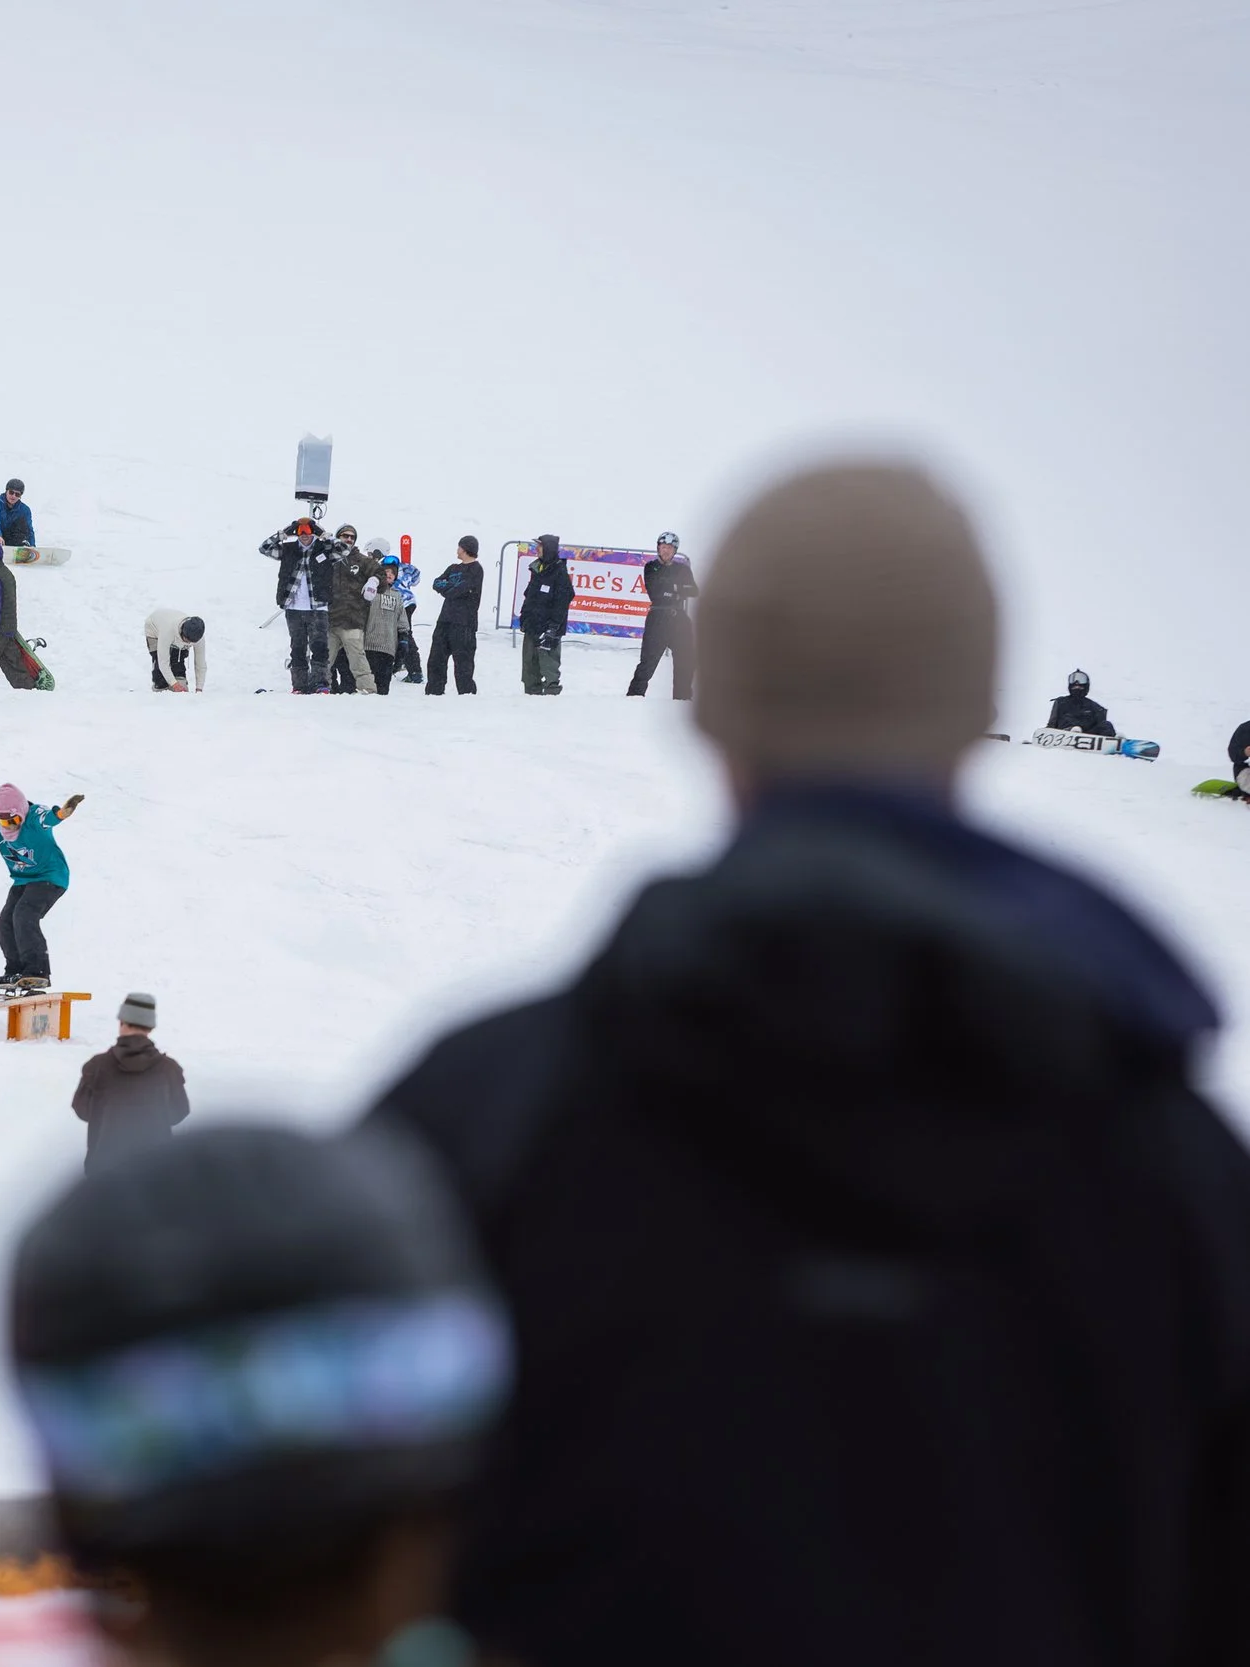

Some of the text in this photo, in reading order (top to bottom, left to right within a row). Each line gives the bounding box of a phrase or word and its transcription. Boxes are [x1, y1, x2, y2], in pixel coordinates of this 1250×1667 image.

[568, 566, 623, 592] ine's
[592, 601, 619, 611] Supplies
[623, 604, 648, 612] Classes
[1074, 737, 1121, 751] LIB
